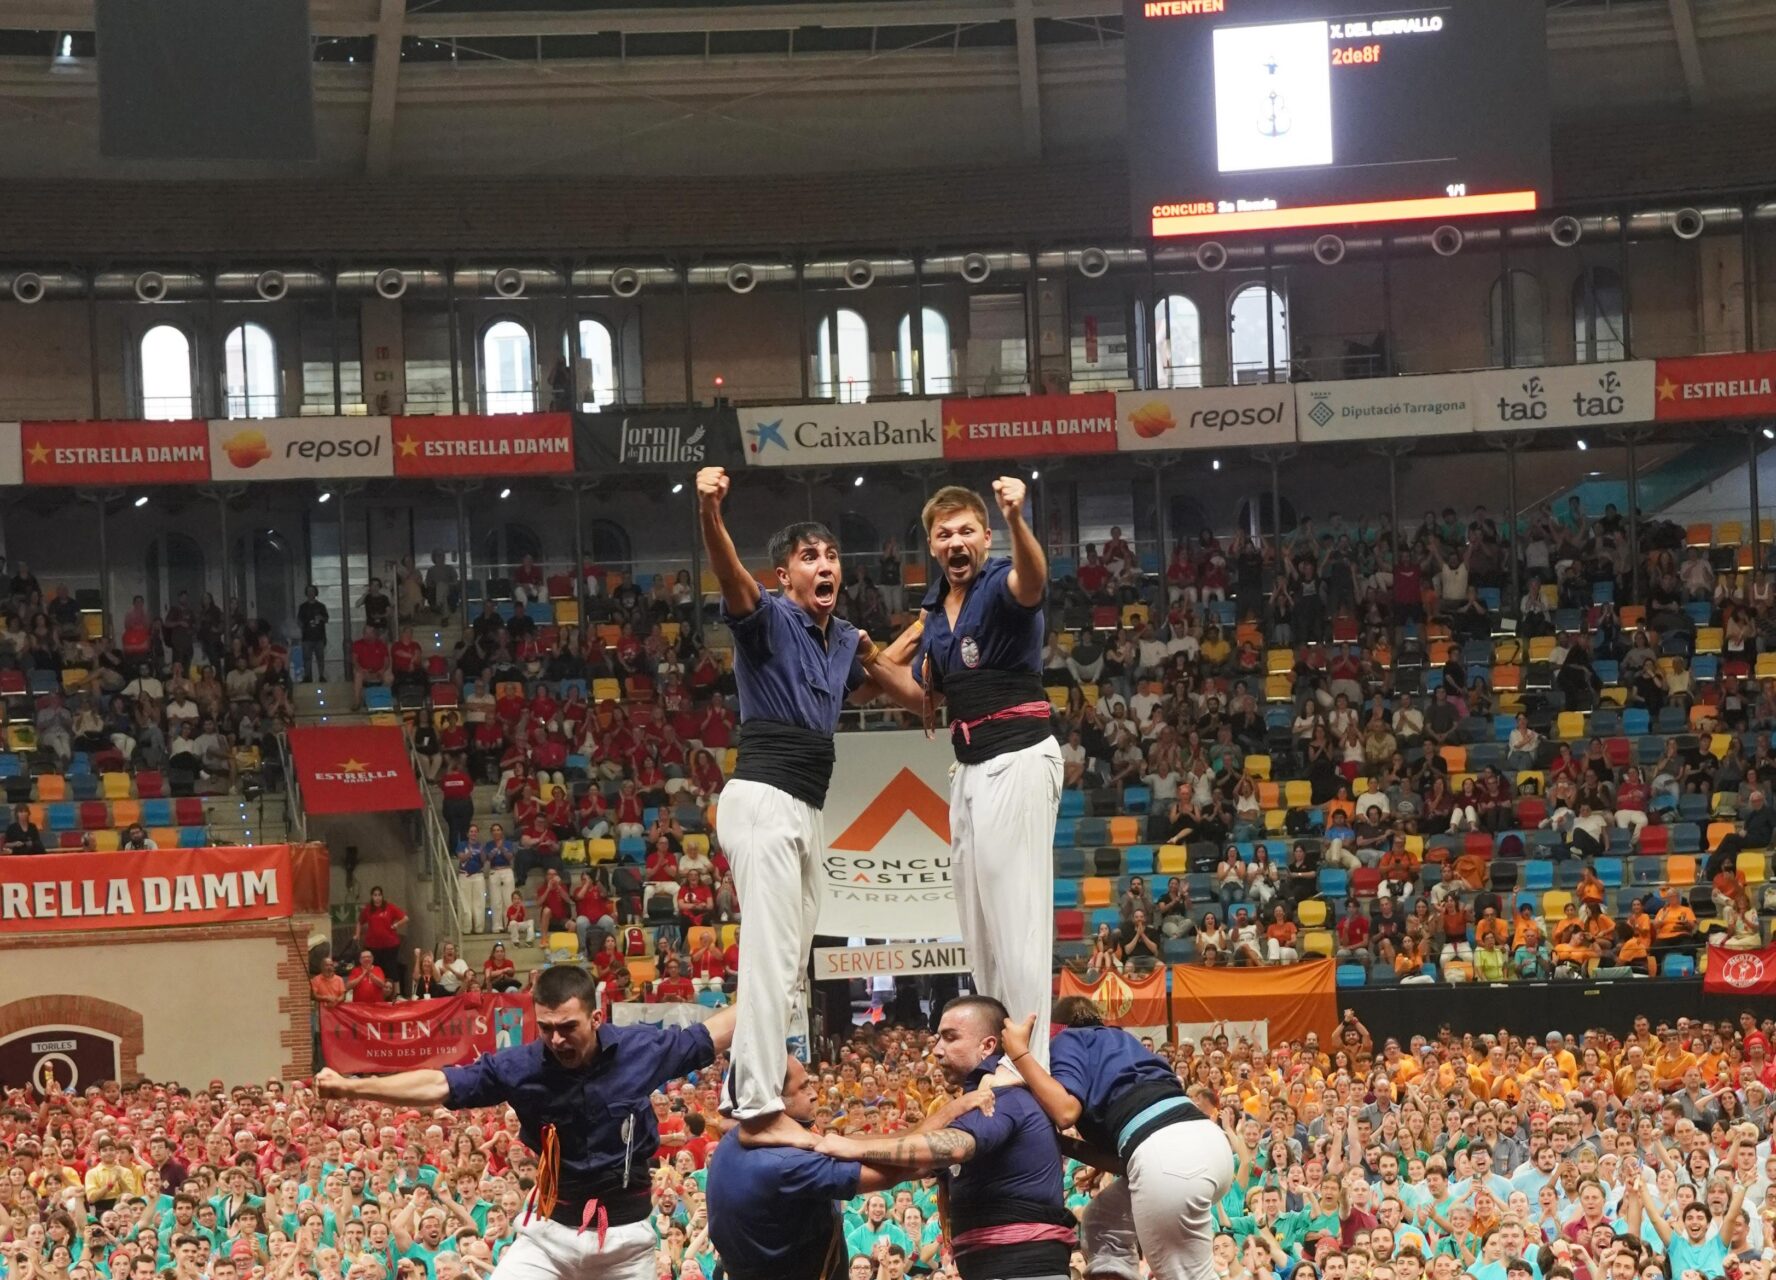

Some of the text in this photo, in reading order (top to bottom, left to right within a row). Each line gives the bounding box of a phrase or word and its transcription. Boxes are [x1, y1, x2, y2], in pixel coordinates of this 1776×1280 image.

[1145, 0, 1224, 17] INTENTEN
[1331, 45, 1380, 65] 2de8f
[1152, 202, 1215, 217] CONCURS
[1683, 378, 1772, 399] ESTRELLA
[1341, 401, 1466, 419] Diputació Tarragona
[1497, 397, 1547, 421] tac
[1573, 391, 1624, 417] tac
[1189, 402, 1285, 431] repsol
[794, 420, 937, 448] CaixaBank
[968, 417, 1112, 439] ESTRELLA DAMM
[55, 445, 205, 464] ESTRELLA DAMM
[286, 434, 381, 460] repsol
[424, 436, 569, 457] ESTRELLA DAMM
[315, 770, 398, 780] ESTRELLA
[827, 856, 952, 870] CONCU
[828, 870, 953, 884] CASTEL
[142, 868, 280, 914] DAMM
[828, 950, 904, 973] SERVEIS
[36, 1040, 73, 1052] TORILES
[366, 1048, 393, 1058] NENS
[397, 1048, 417, 1057] DES
[420, 1047, 433, 1056] DE
